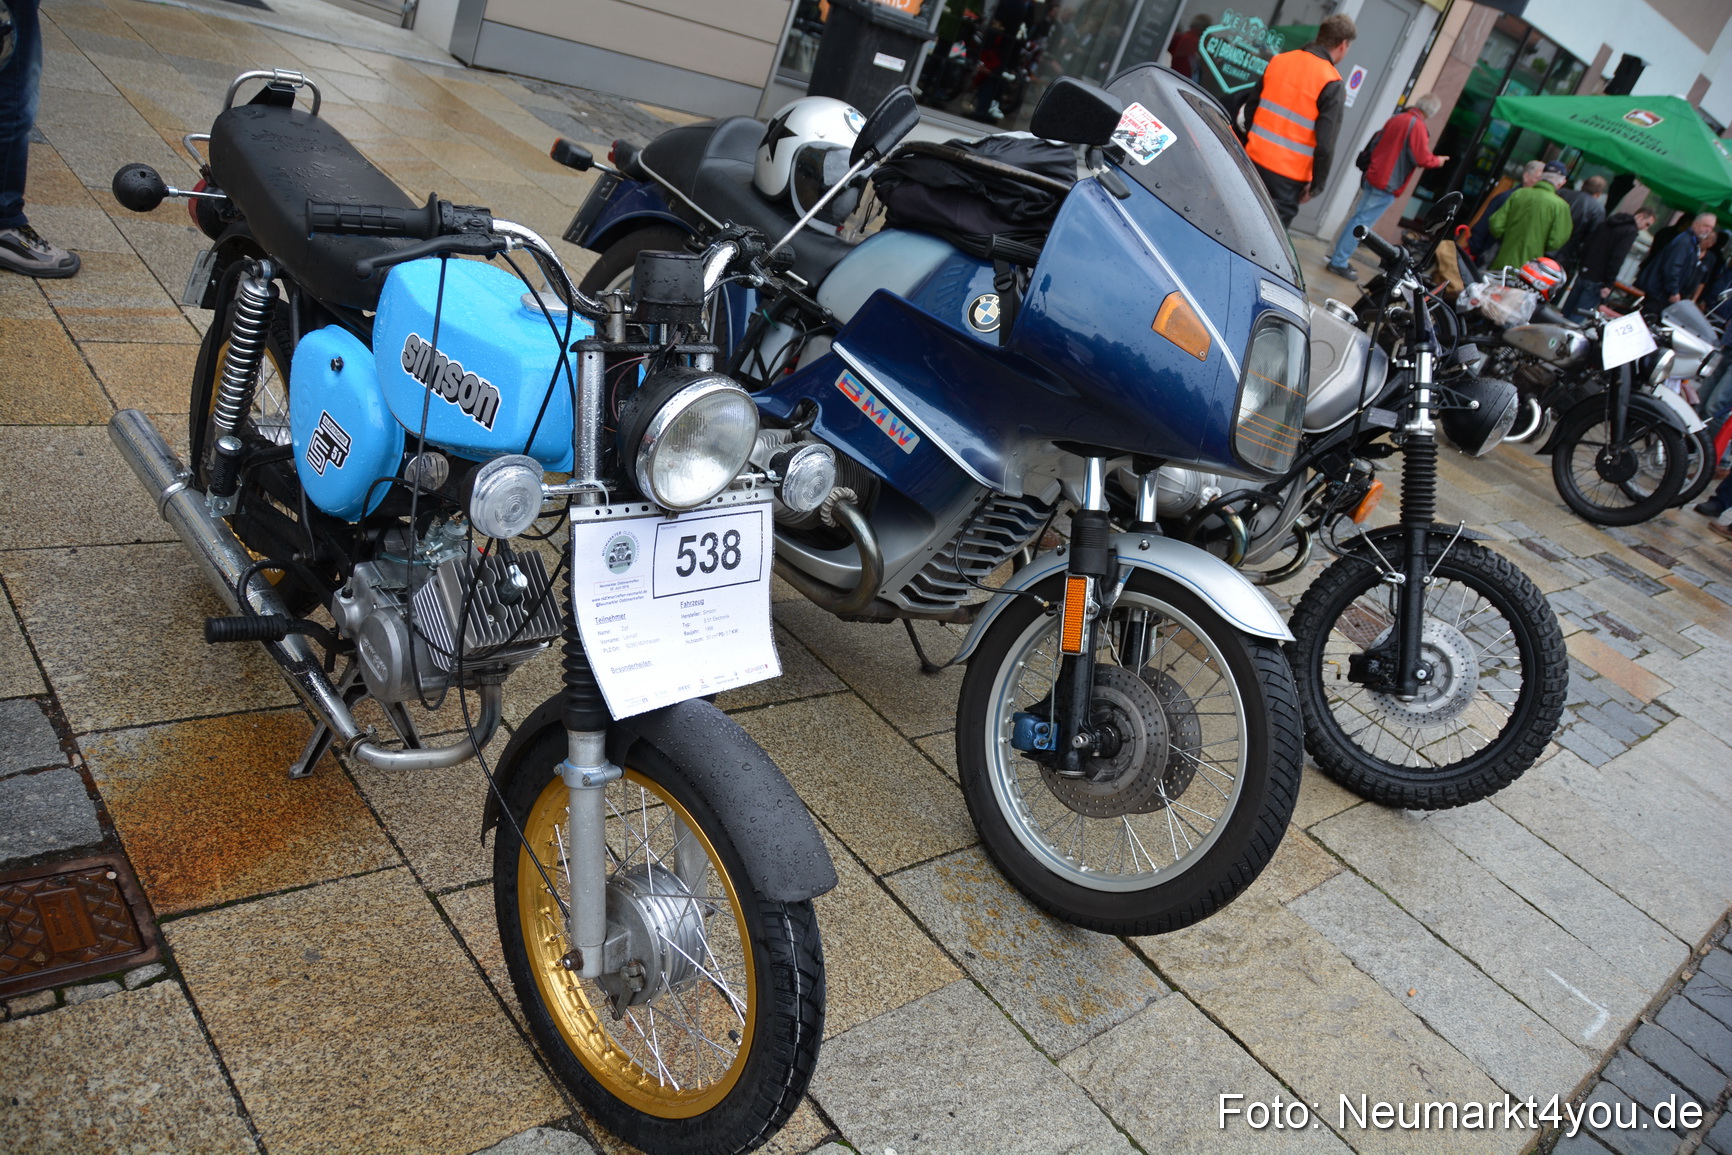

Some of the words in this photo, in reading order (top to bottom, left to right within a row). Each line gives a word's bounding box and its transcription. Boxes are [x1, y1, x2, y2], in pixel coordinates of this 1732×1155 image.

[1222, 9, 1284, 48] WELCOME
[1615, 323, 1634, 337] 129
[402, 334, 500, 430] simson
[838, 372, 916, 447] BMW
[676, 529, 742, 578] 538
[680, 598, 705, 609] Fahrzeug
[680, 611, 702, 619] Hersteller:
[594, 613, 627, 625] Teilnehmer
